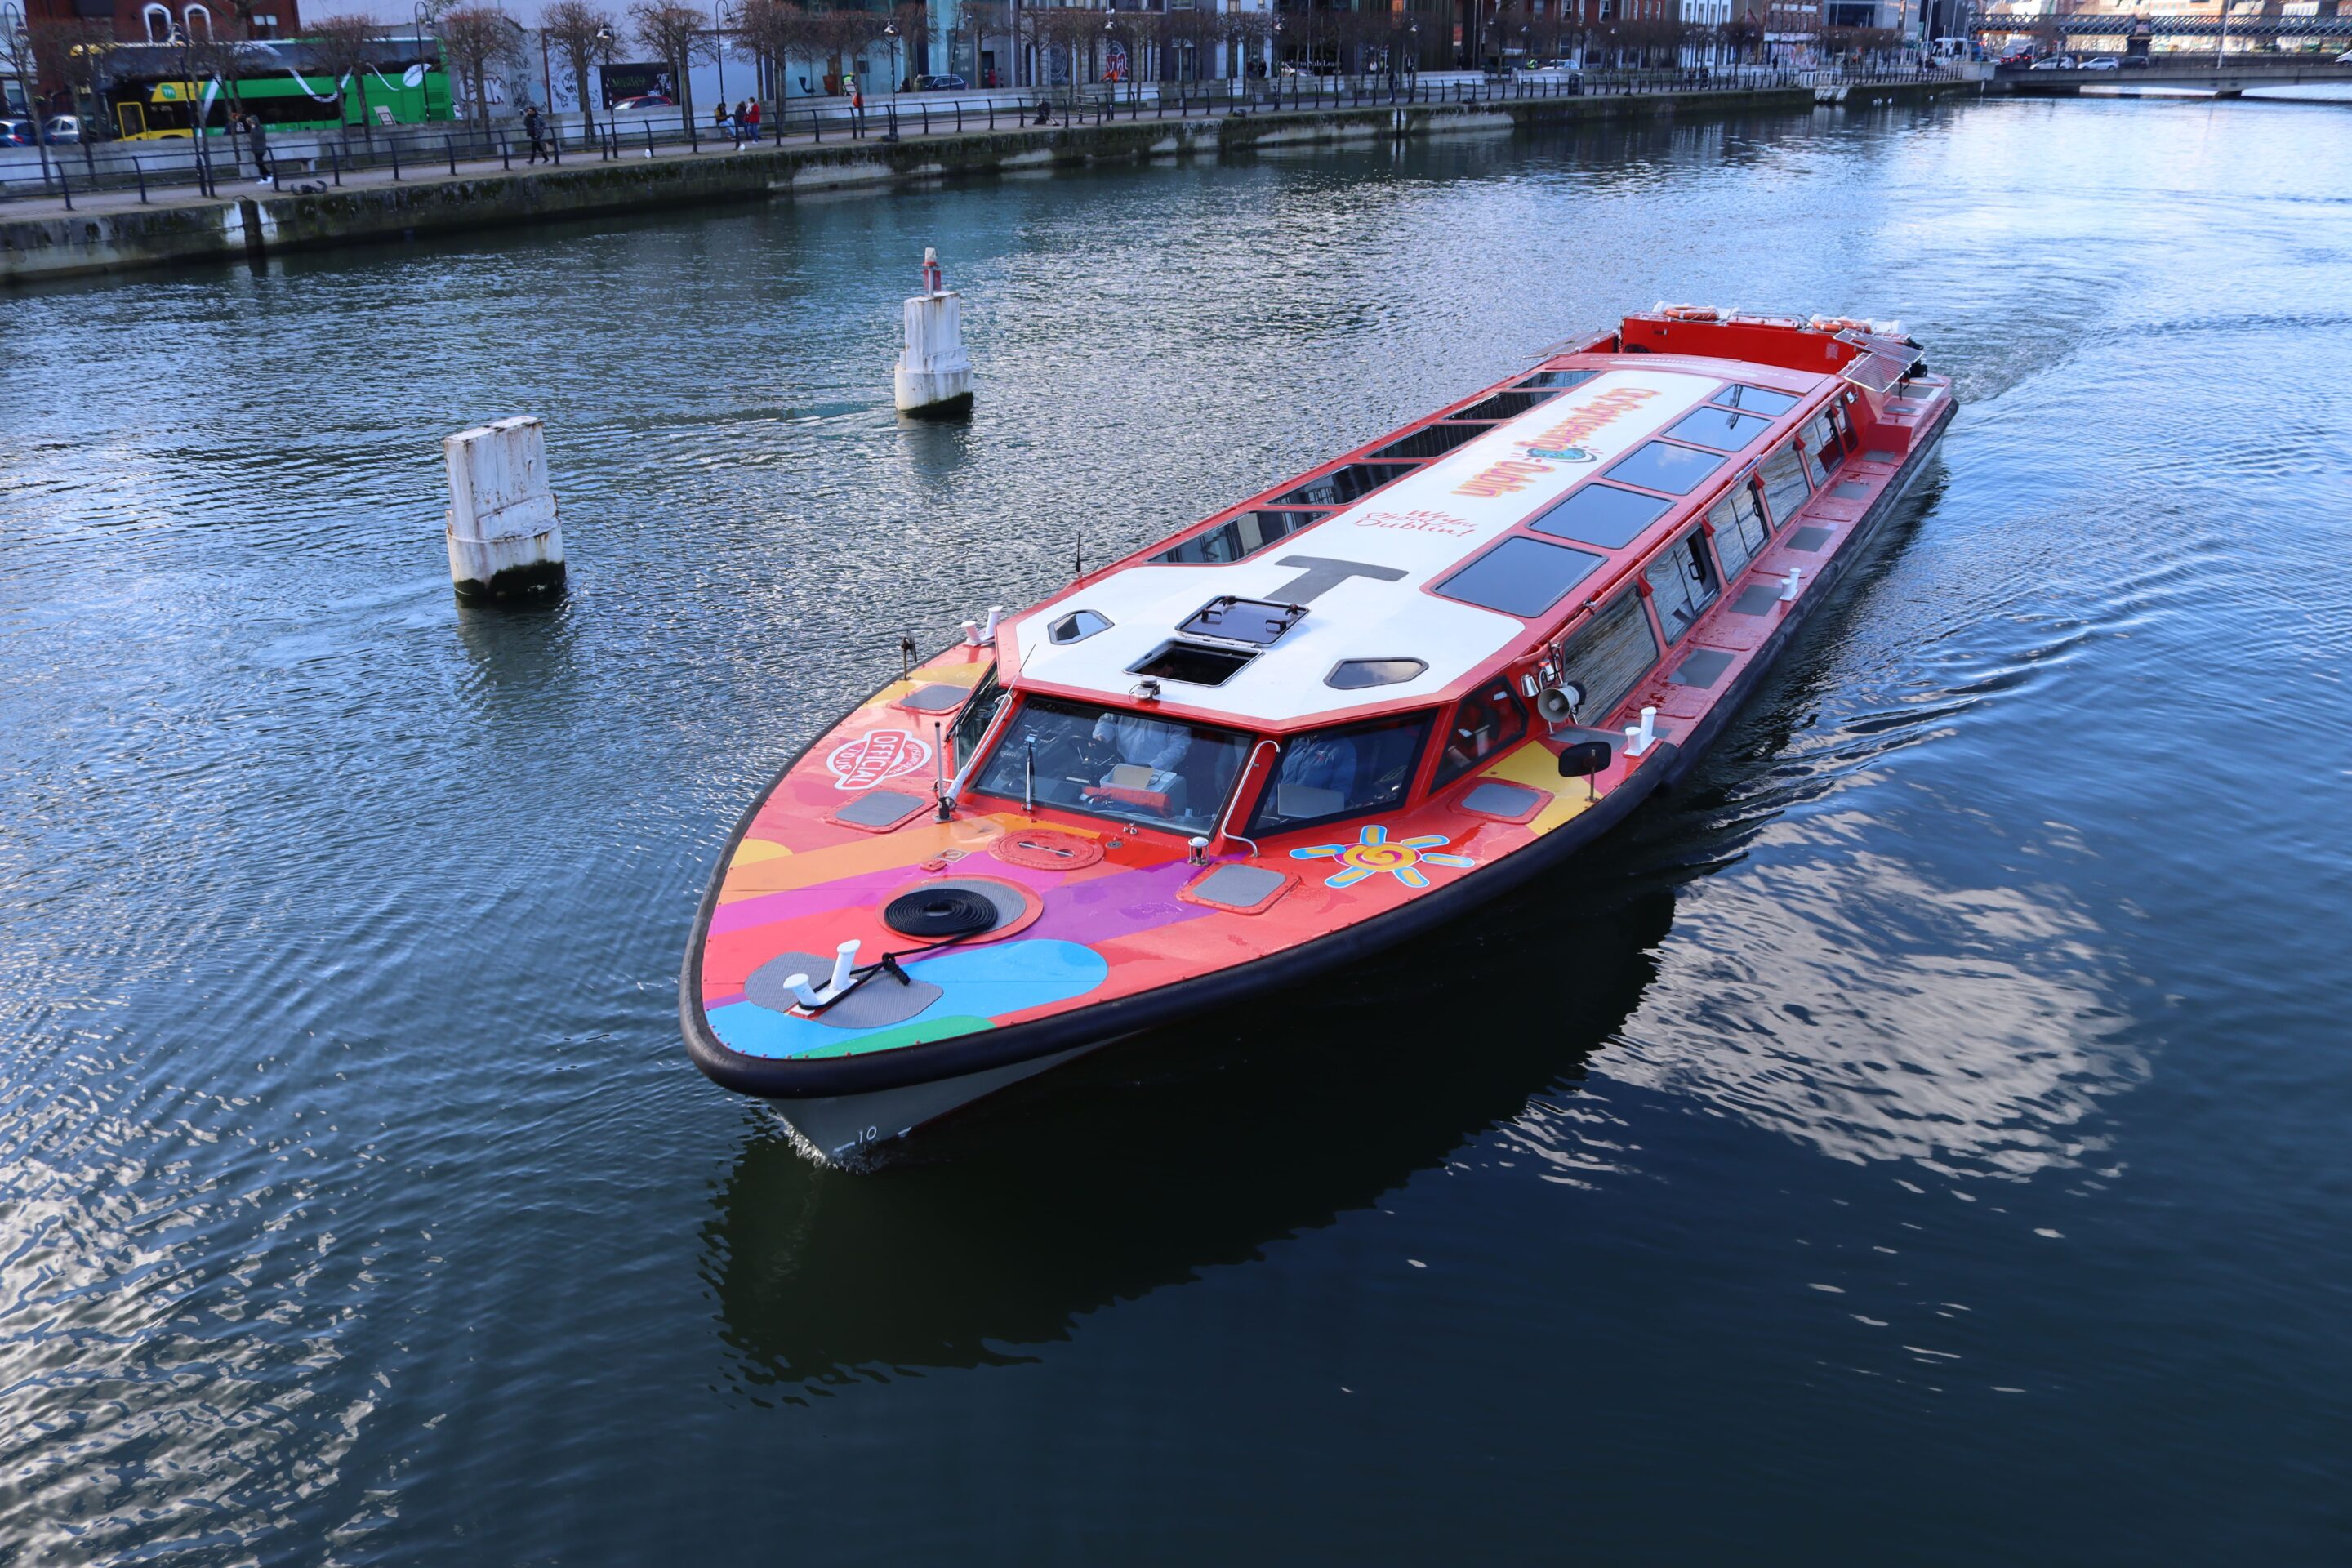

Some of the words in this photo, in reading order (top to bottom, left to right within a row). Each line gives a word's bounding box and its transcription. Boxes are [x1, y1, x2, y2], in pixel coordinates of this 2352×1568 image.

[1450, 461, 1556, 497] Dublin
[1353, 519, 1477, 537] Dublin!
[835, 748, 860, 771] TOUR
[845, 735, 899, 784] OFFICIAL
[858, 1125, 877, 1144] 10
